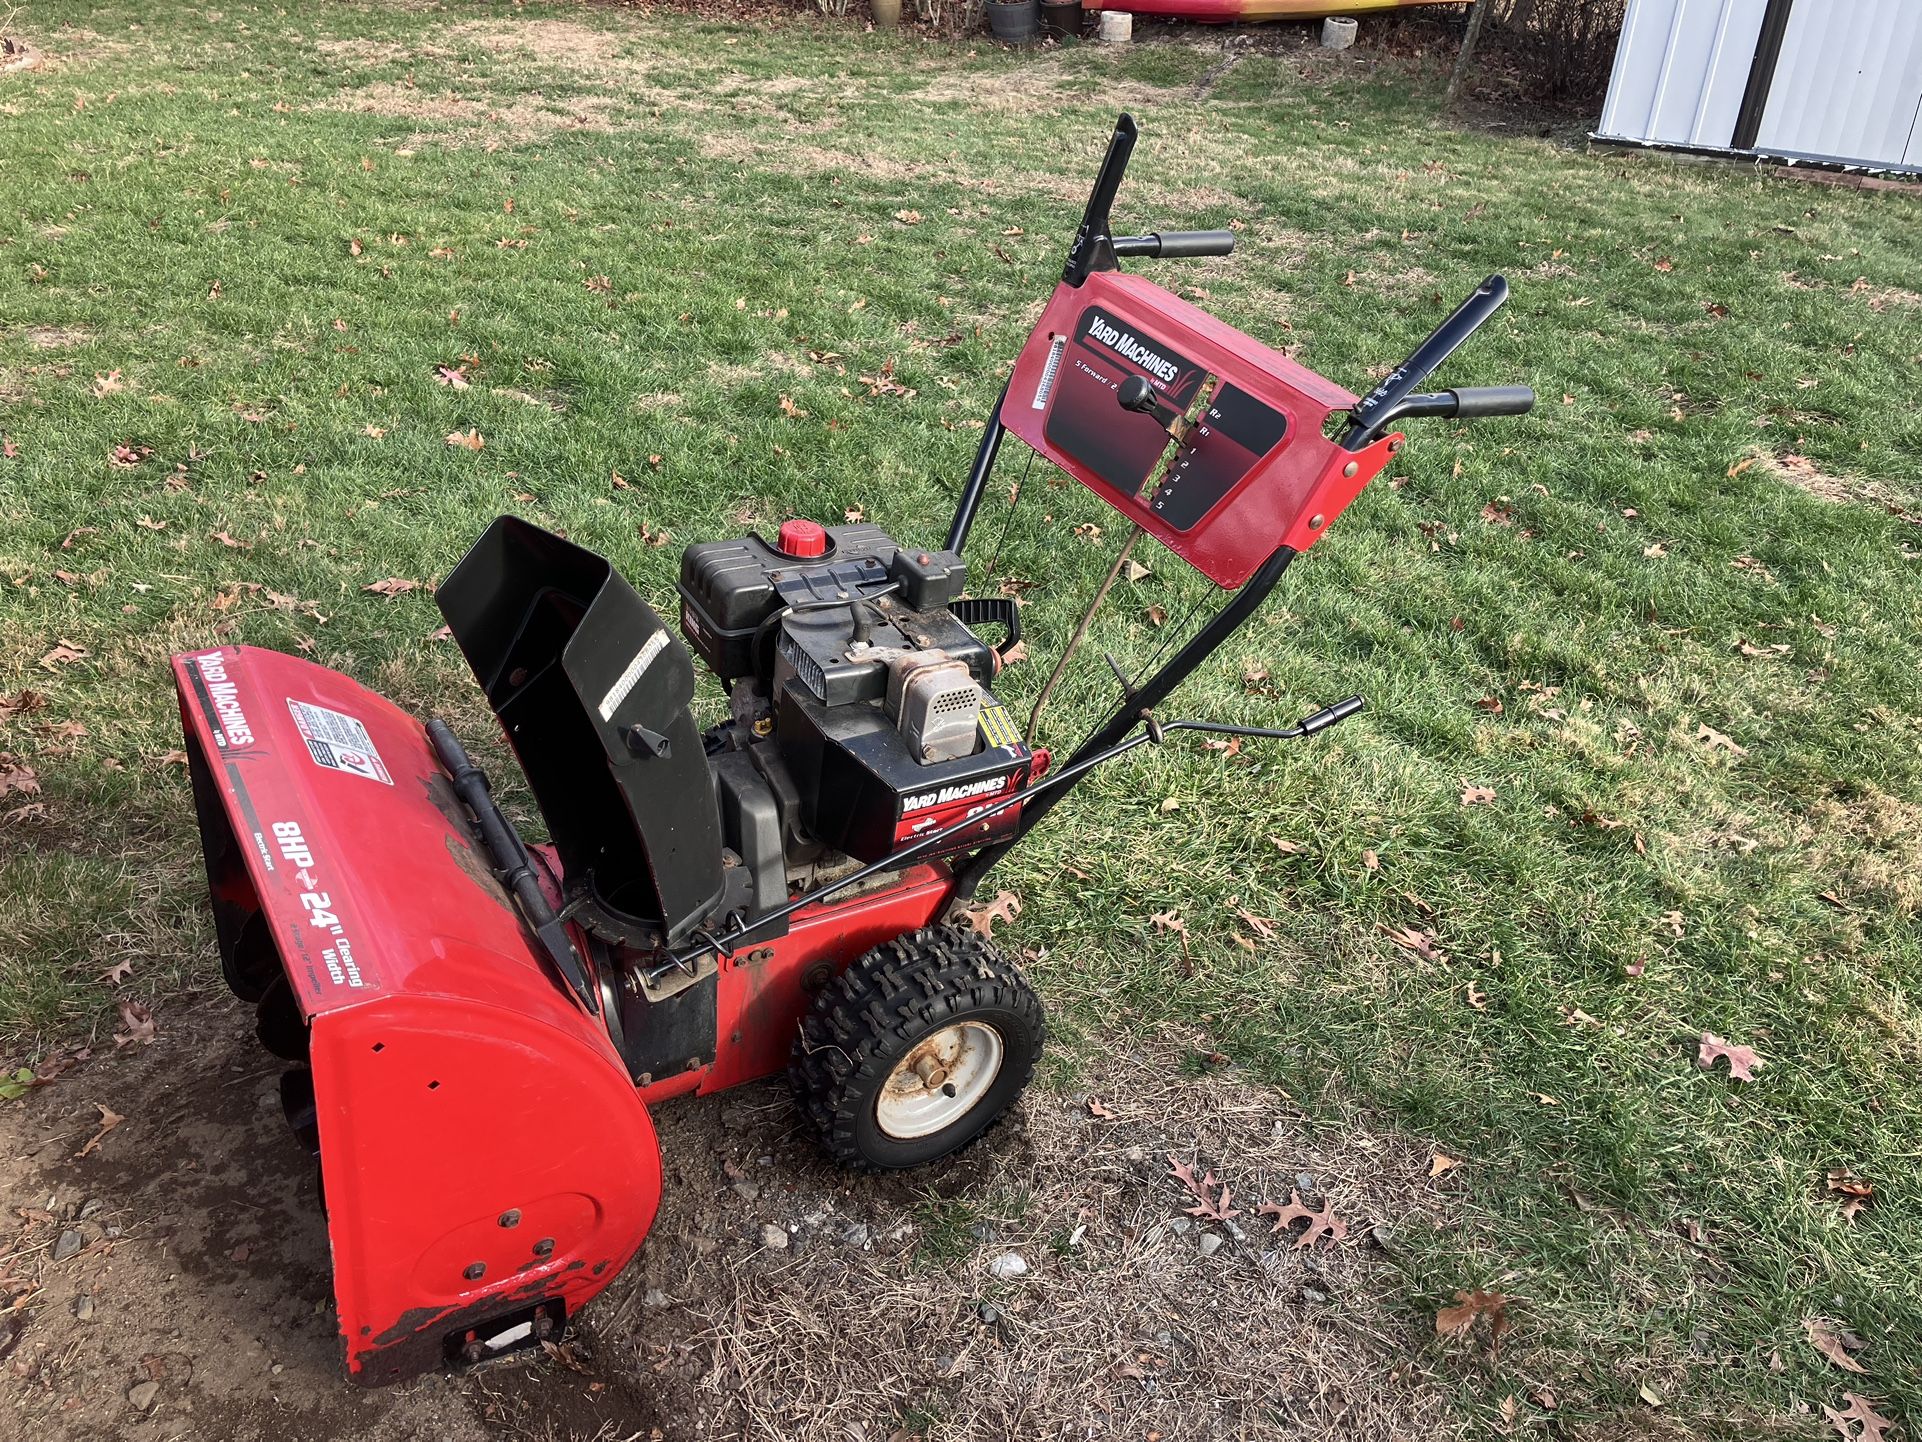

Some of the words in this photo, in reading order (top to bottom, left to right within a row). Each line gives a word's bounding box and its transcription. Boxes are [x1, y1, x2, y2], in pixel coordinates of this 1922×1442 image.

[1087, 315, 1120, 346] YARD
[1114, 333, 1178, 382] MACHINES
[1074, 359, 1082, 367] 5
[1080, 363, 1108, 384] Forward
[1110, 382, 1117, 390] 2
[1153, 378, 1167, 390] MTD
[1209, 408, 1222, 420] R2
[1199, 426, 1210, 437] R1
[1189, 447, 1197, 455] 1
[1180, 460, 1189, 469] 2
[1172, 474, 1181, 483] 3
[1164, 488, 1173, 496] 4
[1155, 501, 1165, 510] 5
[197, 650, 228, 682] YARD
[208, 681, 255, 746] MACHINES
[214, 733, 227, 747] MTD
[902, 793, 937, 813] YARD
[936, 775, 1007, 804] MACHINES
[271, 820, 314, 868] 8HP
[900, 832, 925, 842] Electric
[254, 832, 269, 858] Electric
[265, 854, 275, 871] Start
[322, 948, 346, 985] Width
[335, 937, 364, 988] Clearing
